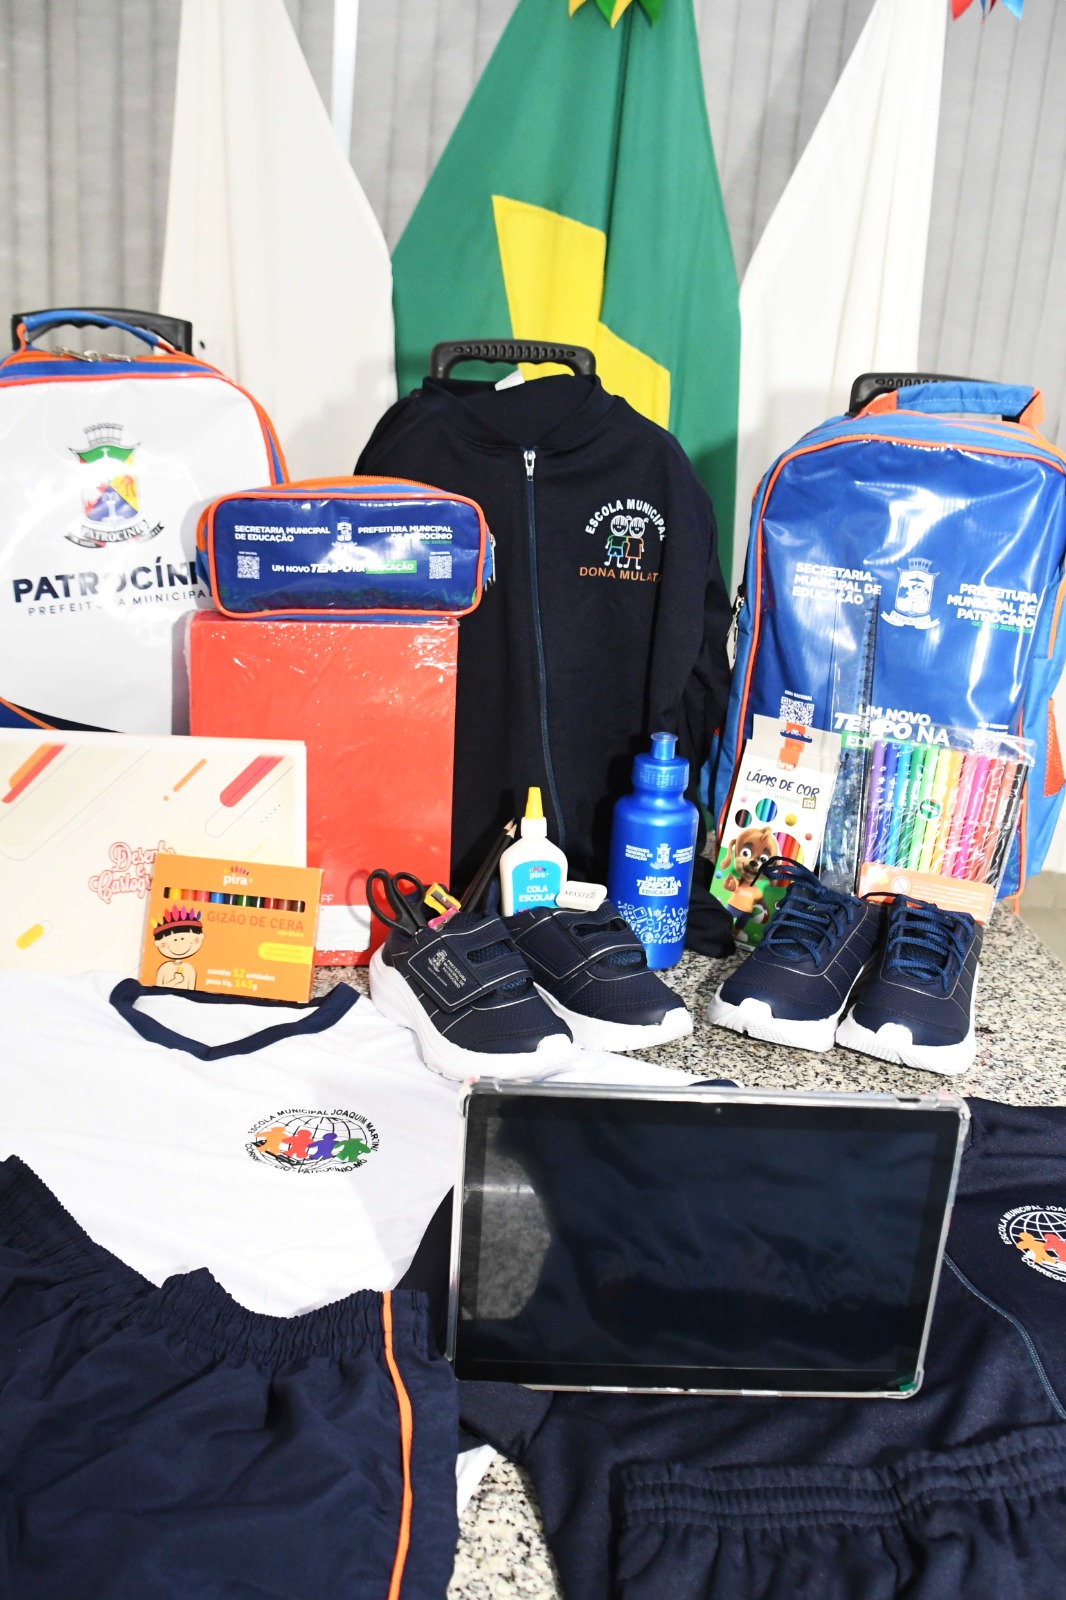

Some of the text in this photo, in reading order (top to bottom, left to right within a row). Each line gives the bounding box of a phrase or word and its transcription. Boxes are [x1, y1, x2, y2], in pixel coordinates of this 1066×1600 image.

[585, 498, 667, 542] ESCOLA MUNICIPAL
[234, 525, 331, 534] SECRETARIA MUNICIPAL
[247, 532, 295, 543] EDUCAÇÃO
[358, 525, 453, 534] PREFEITURA MUNICIPAL
[403, 531, 452, 540] PROCÍNIO
[271, 564, 285, 572] UM
[286, 565, 310, 573] NOVO
[579, 566, 659, 582] DONA MULAT
[795, 562, 873, 582] SECRETARIA
[12, 556, 198, 603] PATROCÍNI
[793, 574, 882, 595] MUNICIPAL DE
[28, 589, 212, 616] PREFEITA MUNICIPA
[792, 585, 864, 605] EDUCAÇÃO
[959, 583, 1038, 604] PREFEITURA
[858, 703, 883, 719] UM
[885, 708, 931, 726] NOVO
[916, 725, 951, 747] NA
[746, 769, 820, 798] LÁPIS DE COR
[223, 873, 249, 886] pira
[529, 871, 546, 880] pira
[88, 869, 153, 905] Cartogr
[526, 884, 548, 893] COLA
[518, 893, 556, 902] ESCOLAR
[206, 909, 304, 931] GIZÃO DE CERA
[233, 968, 246, 978] 12
[247, 1115, 277, 1134] ESCOLA
[277, 1108, 329, 1116] MUNICIPAL
[330, 1108, 368, 1125] JOAQUIM
[1002, 1204, 1044, 1221] MUNICIPAL
[997, 1218, 1013, 1245] ESCOLA
